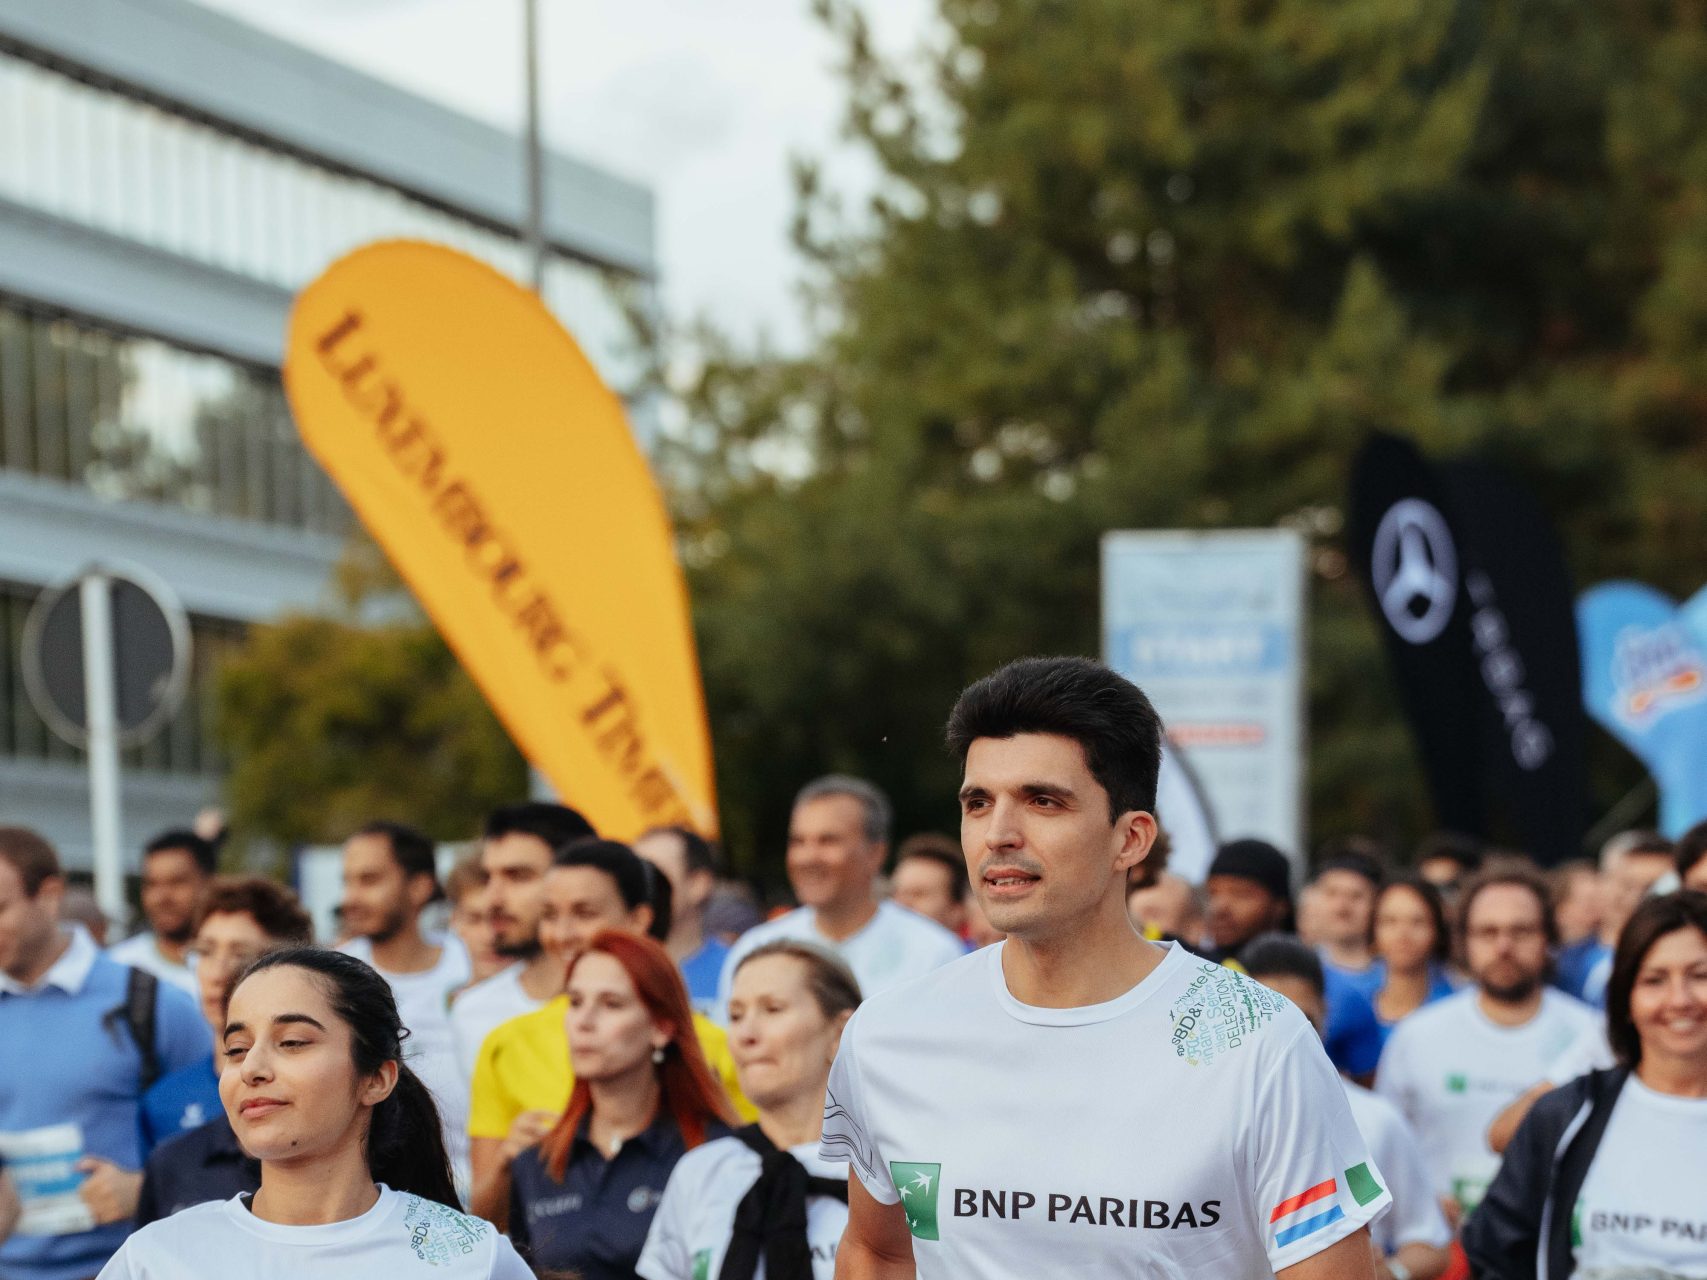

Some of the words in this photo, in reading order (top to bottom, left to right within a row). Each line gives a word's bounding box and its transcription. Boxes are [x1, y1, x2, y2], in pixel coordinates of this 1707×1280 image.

[953, 1188, 1036, 1220] BNP
[1048, 1193, 1221, 1230] PARIBAS
[1591, 1211, 1652, 1233] BNP
